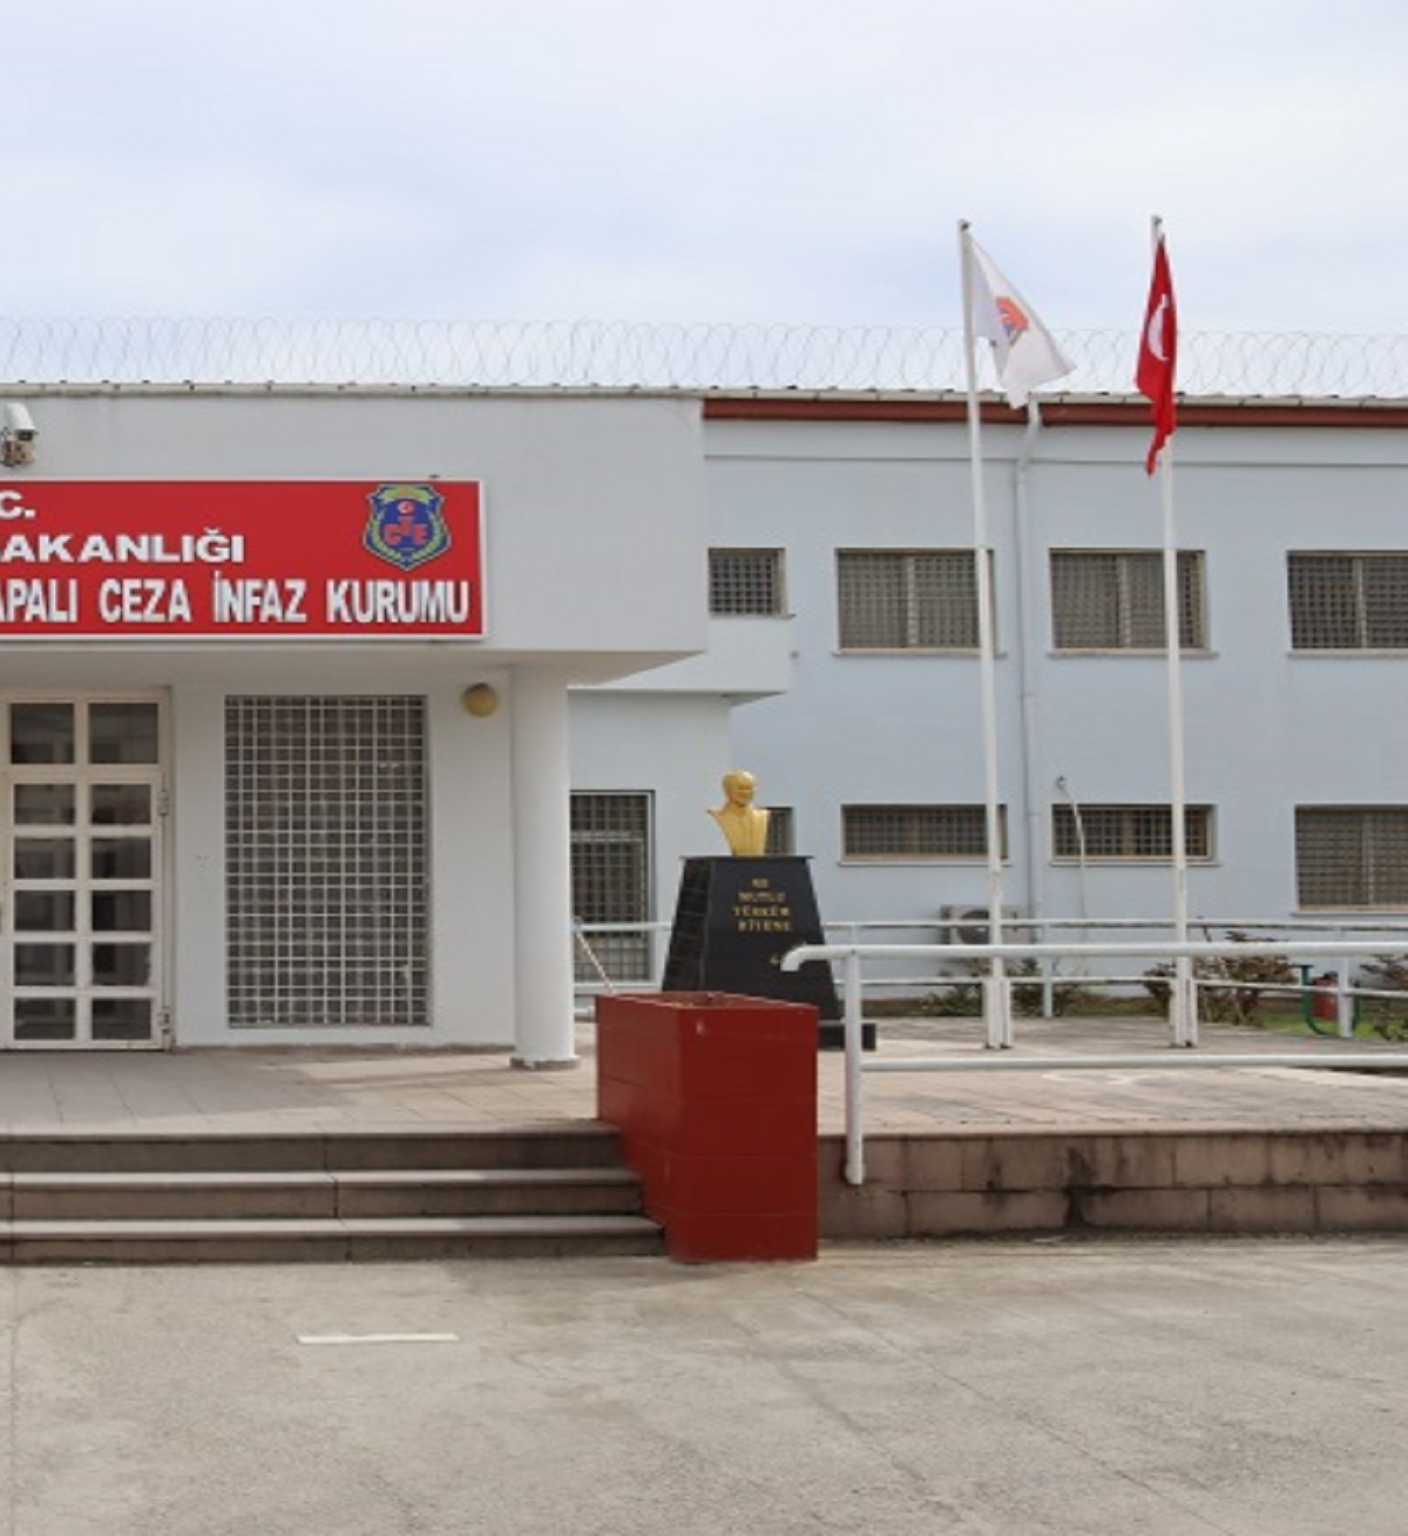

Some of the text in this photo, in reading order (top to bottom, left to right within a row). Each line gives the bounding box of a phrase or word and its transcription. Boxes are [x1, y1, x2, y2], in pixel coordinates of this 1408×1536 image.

[99, 578, 192, 623] CEZA
[213, 570, 307, 623] İNFAZ
[326, 578, 469, 623] KURUMU
